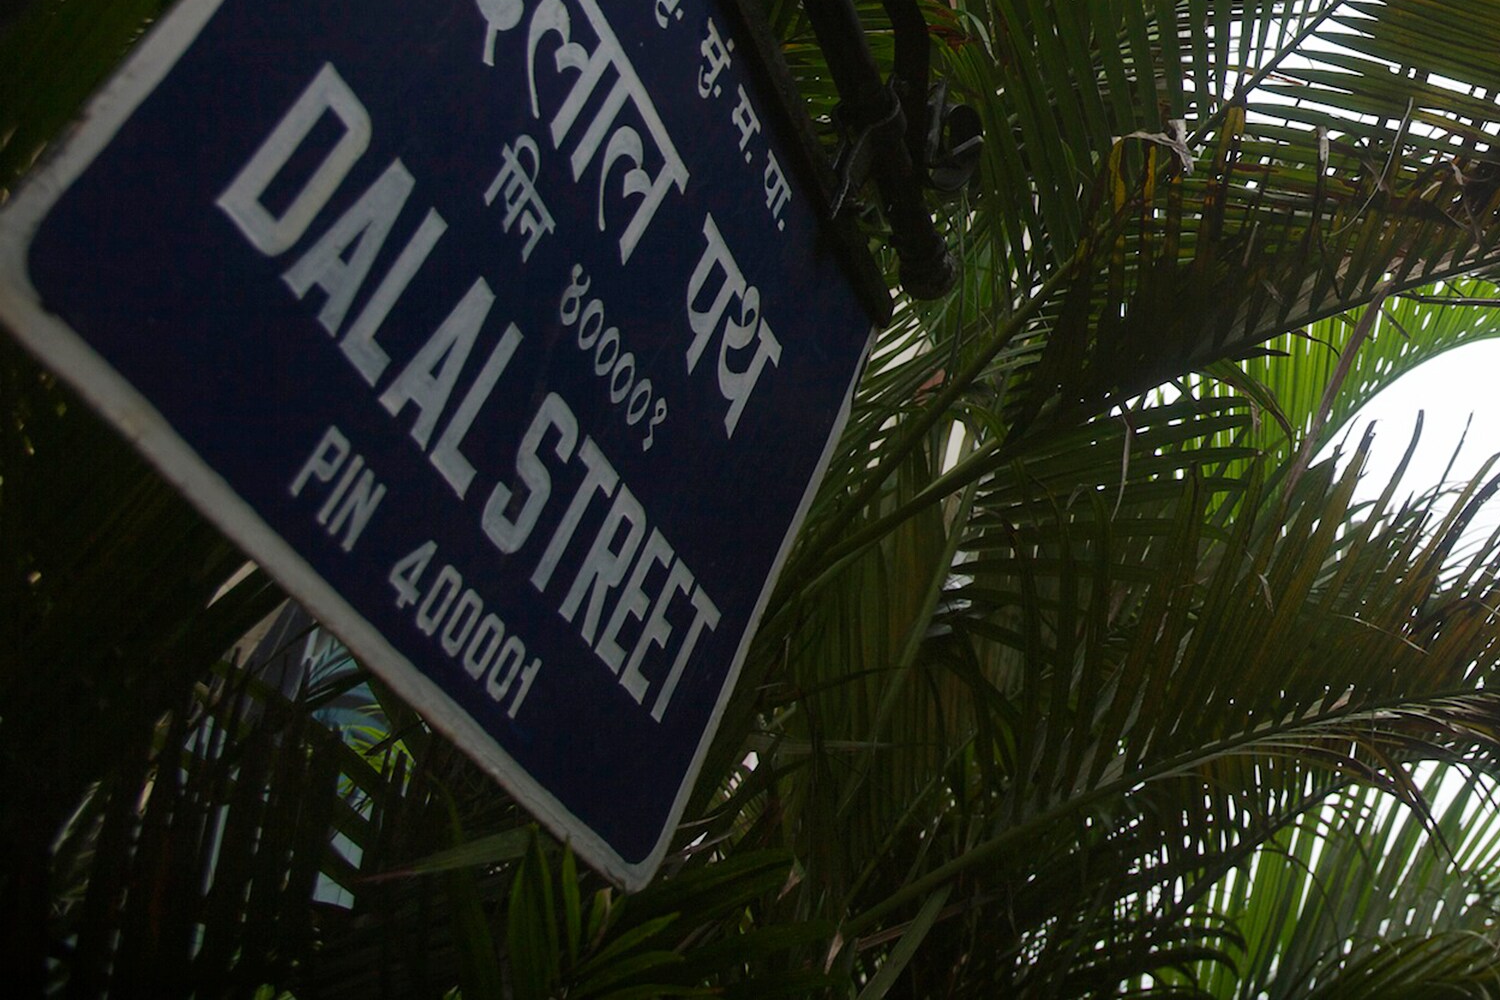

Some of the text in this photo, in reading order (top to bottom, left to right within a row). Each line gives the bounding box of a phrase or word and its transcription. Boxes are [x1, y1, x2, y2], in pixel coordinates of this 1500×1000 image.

[697, 17, 735, 99] मुं.
[731, 83, 761, 164] म.
[764, 149, 792, 231] पा.
[216, 62, 722, 723] DALAL STREET
[484, 134, 667, 451] पिन ४००००१
[686, 212, 782, 439] पथ
[291, 426, 542, 719] PIN 400001
